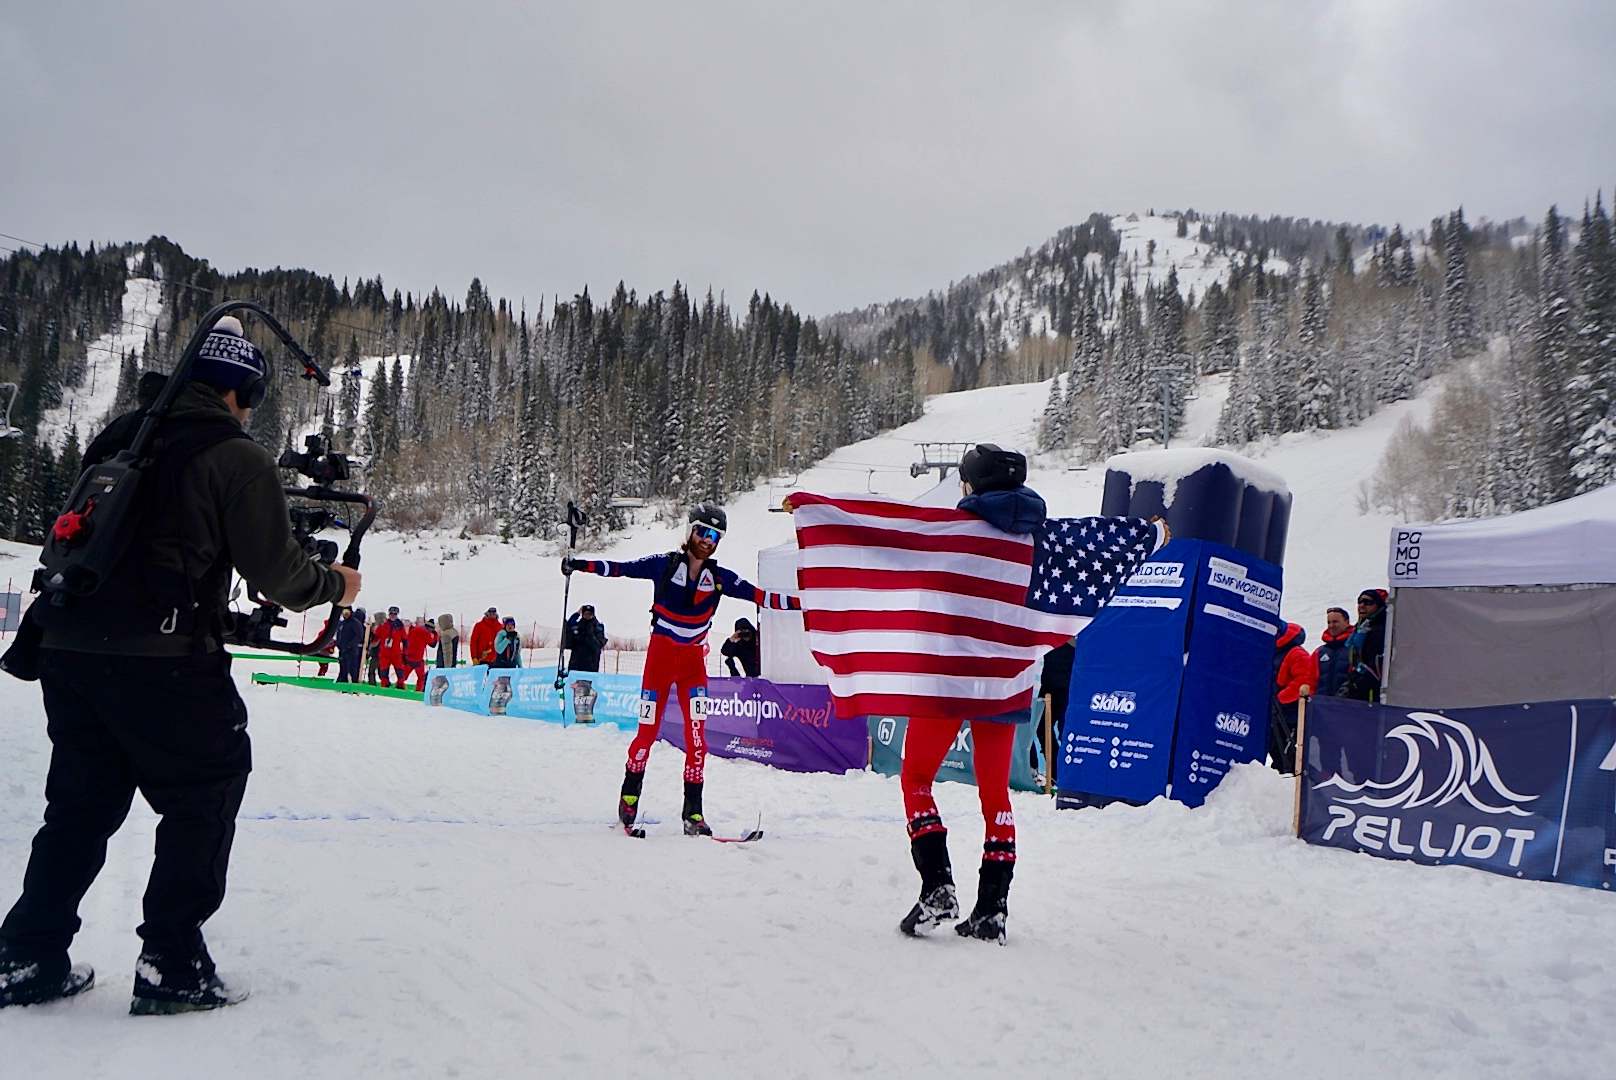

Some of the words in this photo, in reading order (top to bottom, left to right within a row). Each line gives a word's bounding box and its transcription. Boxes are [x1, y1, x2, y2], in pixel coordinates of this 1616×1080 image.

[1396, 546, 1420, 560] MO
[1155, 566, 1178, 576] CUP
[1395, 562, 1418, 575] CA
[706, 692, 783, 725] azerbaijan
[994, 811, 1014, 825] US
[1321, 805, 1535, 867] PELLIOT
